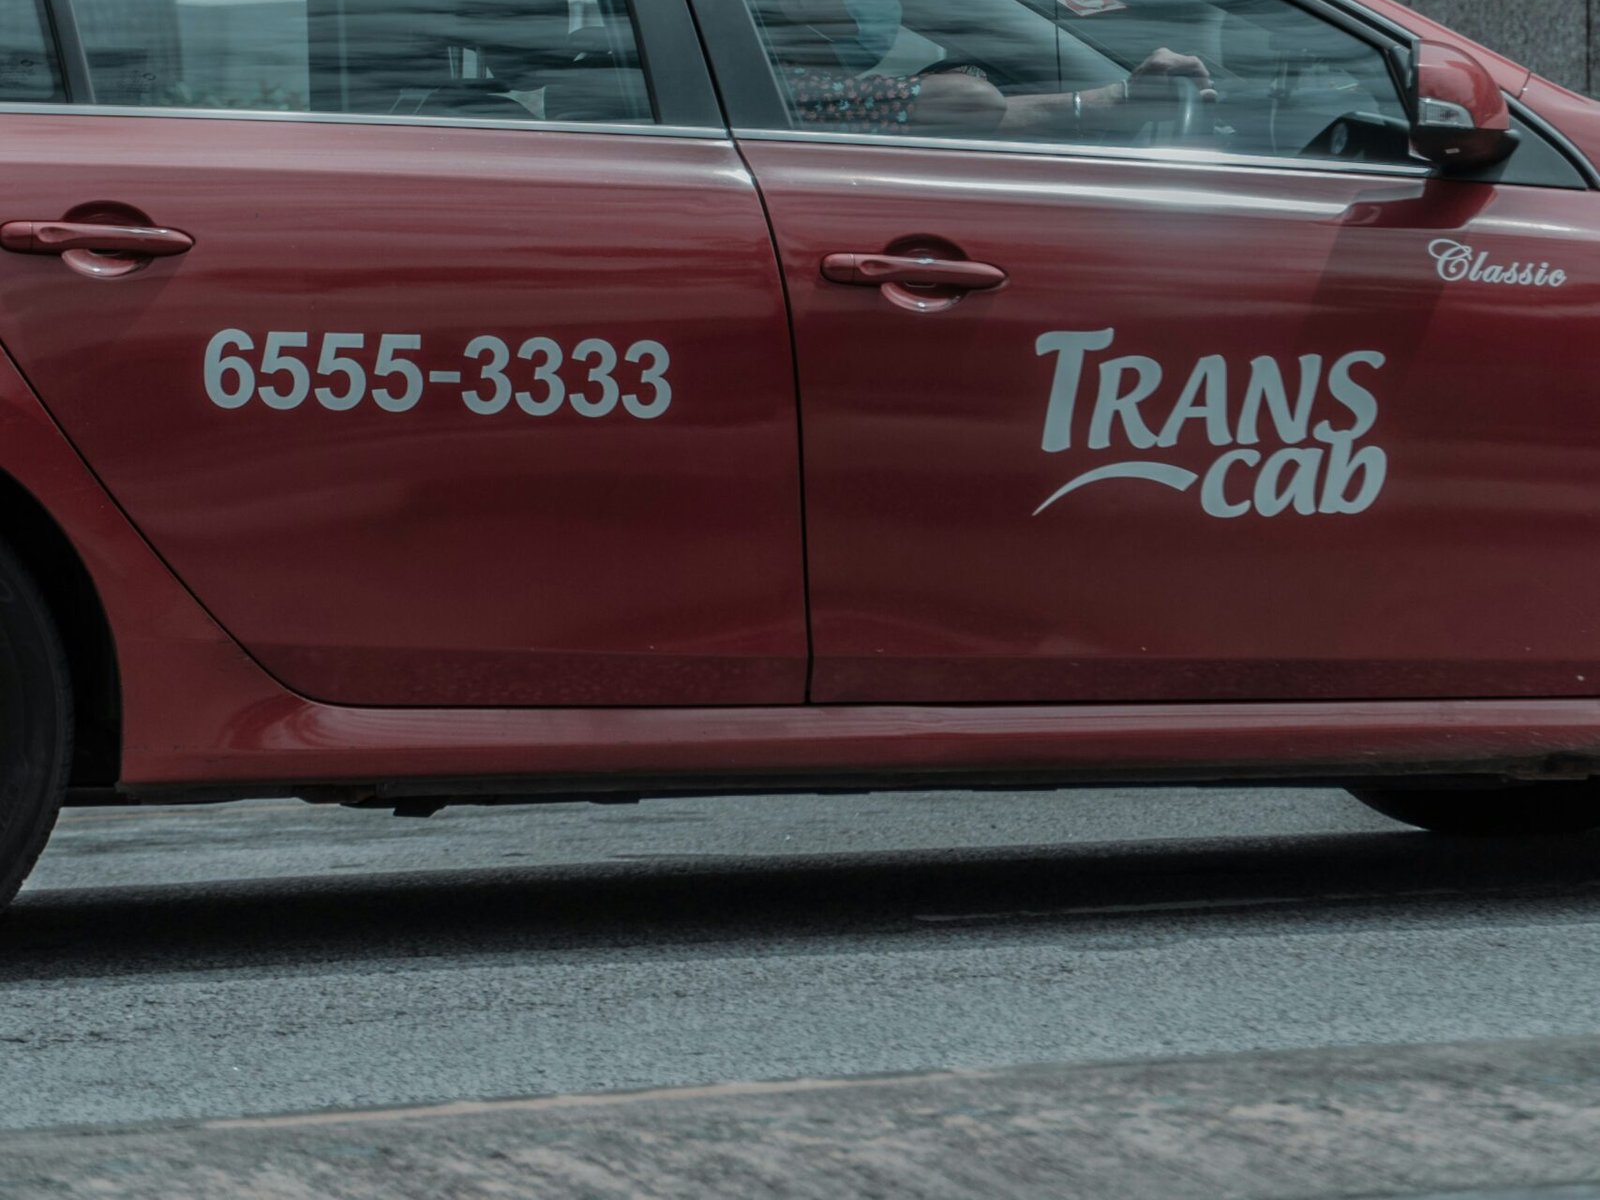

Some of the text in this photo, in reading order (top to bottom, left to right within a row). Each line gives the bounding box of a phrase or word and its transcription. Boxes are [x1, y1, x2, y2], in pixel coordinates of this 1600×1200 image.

[1428, 238, 1567, 287] Classic
[203, 328, 672, 419] 6555-3333
[1035, 327, 1386, 453] TRANS
[1200, 432, 1387, 518] cab
